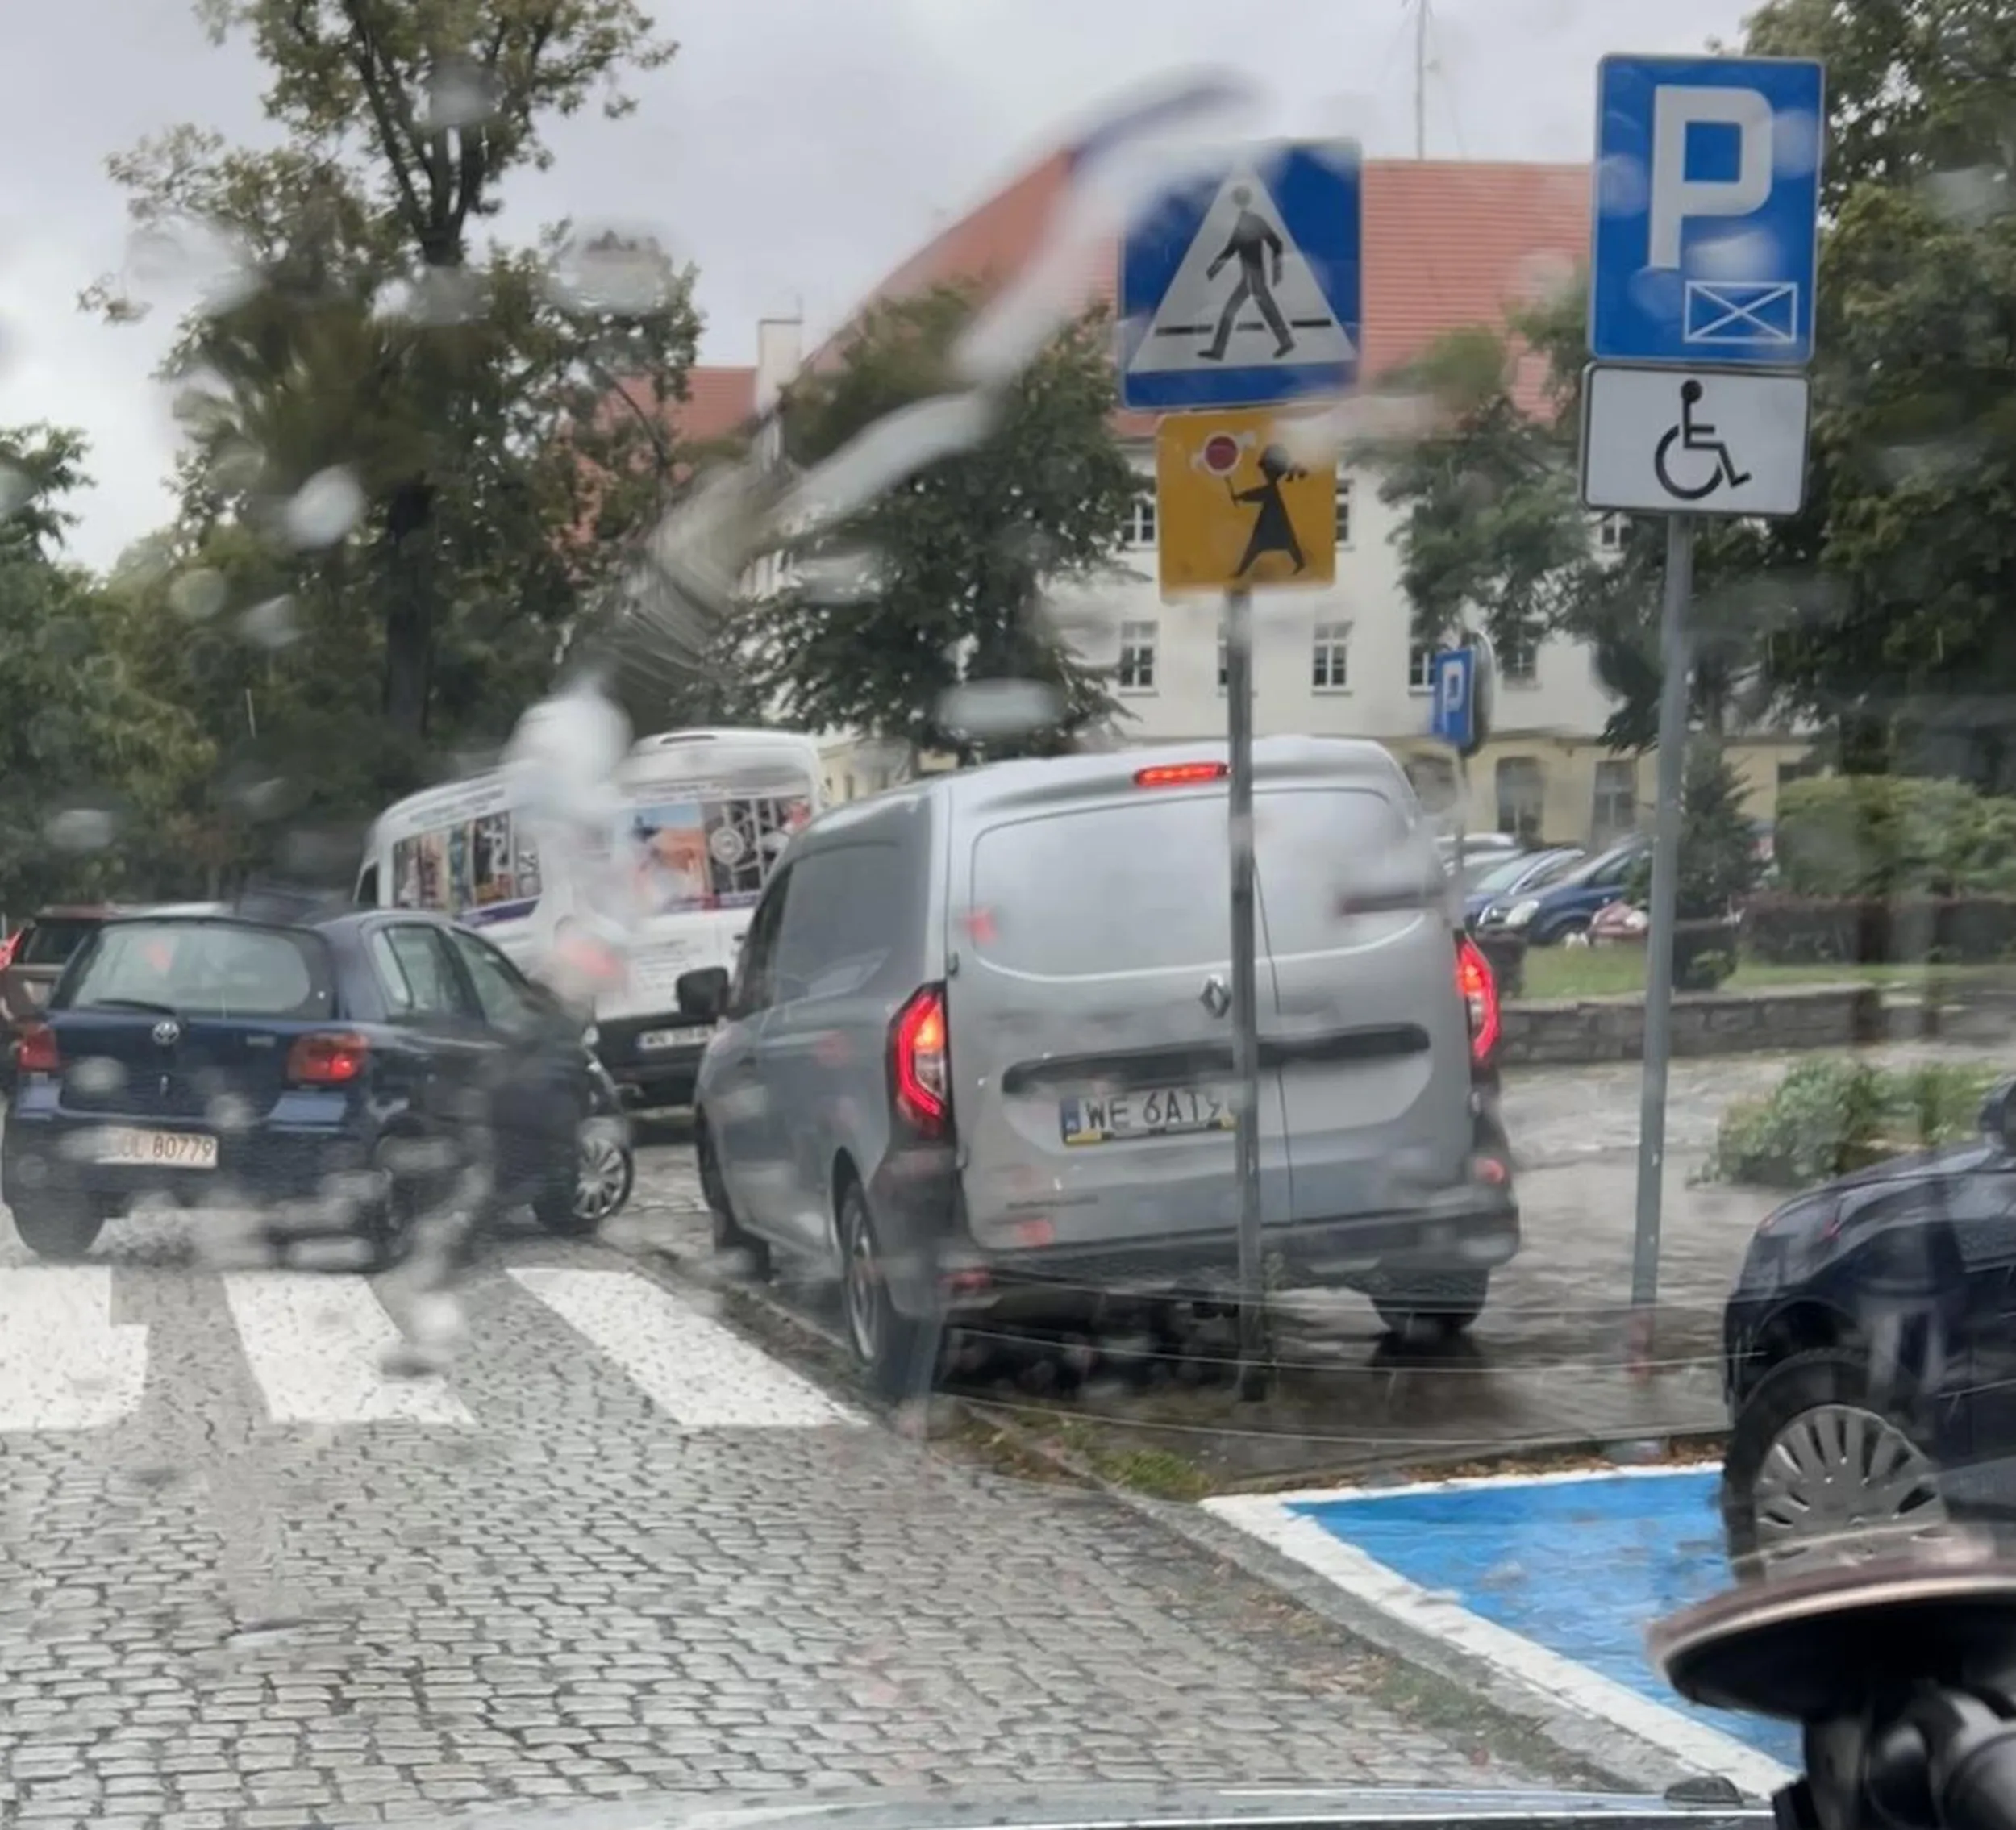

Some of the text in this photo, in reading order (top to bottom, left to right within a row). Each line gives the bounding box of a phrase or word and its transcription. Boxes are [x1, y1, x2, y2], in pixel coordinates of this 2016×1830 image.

[1648, 85, 1773, 269] P
[1442, 660, 1465, 732] P
[1085, 1097, 1129, 1128] WE
